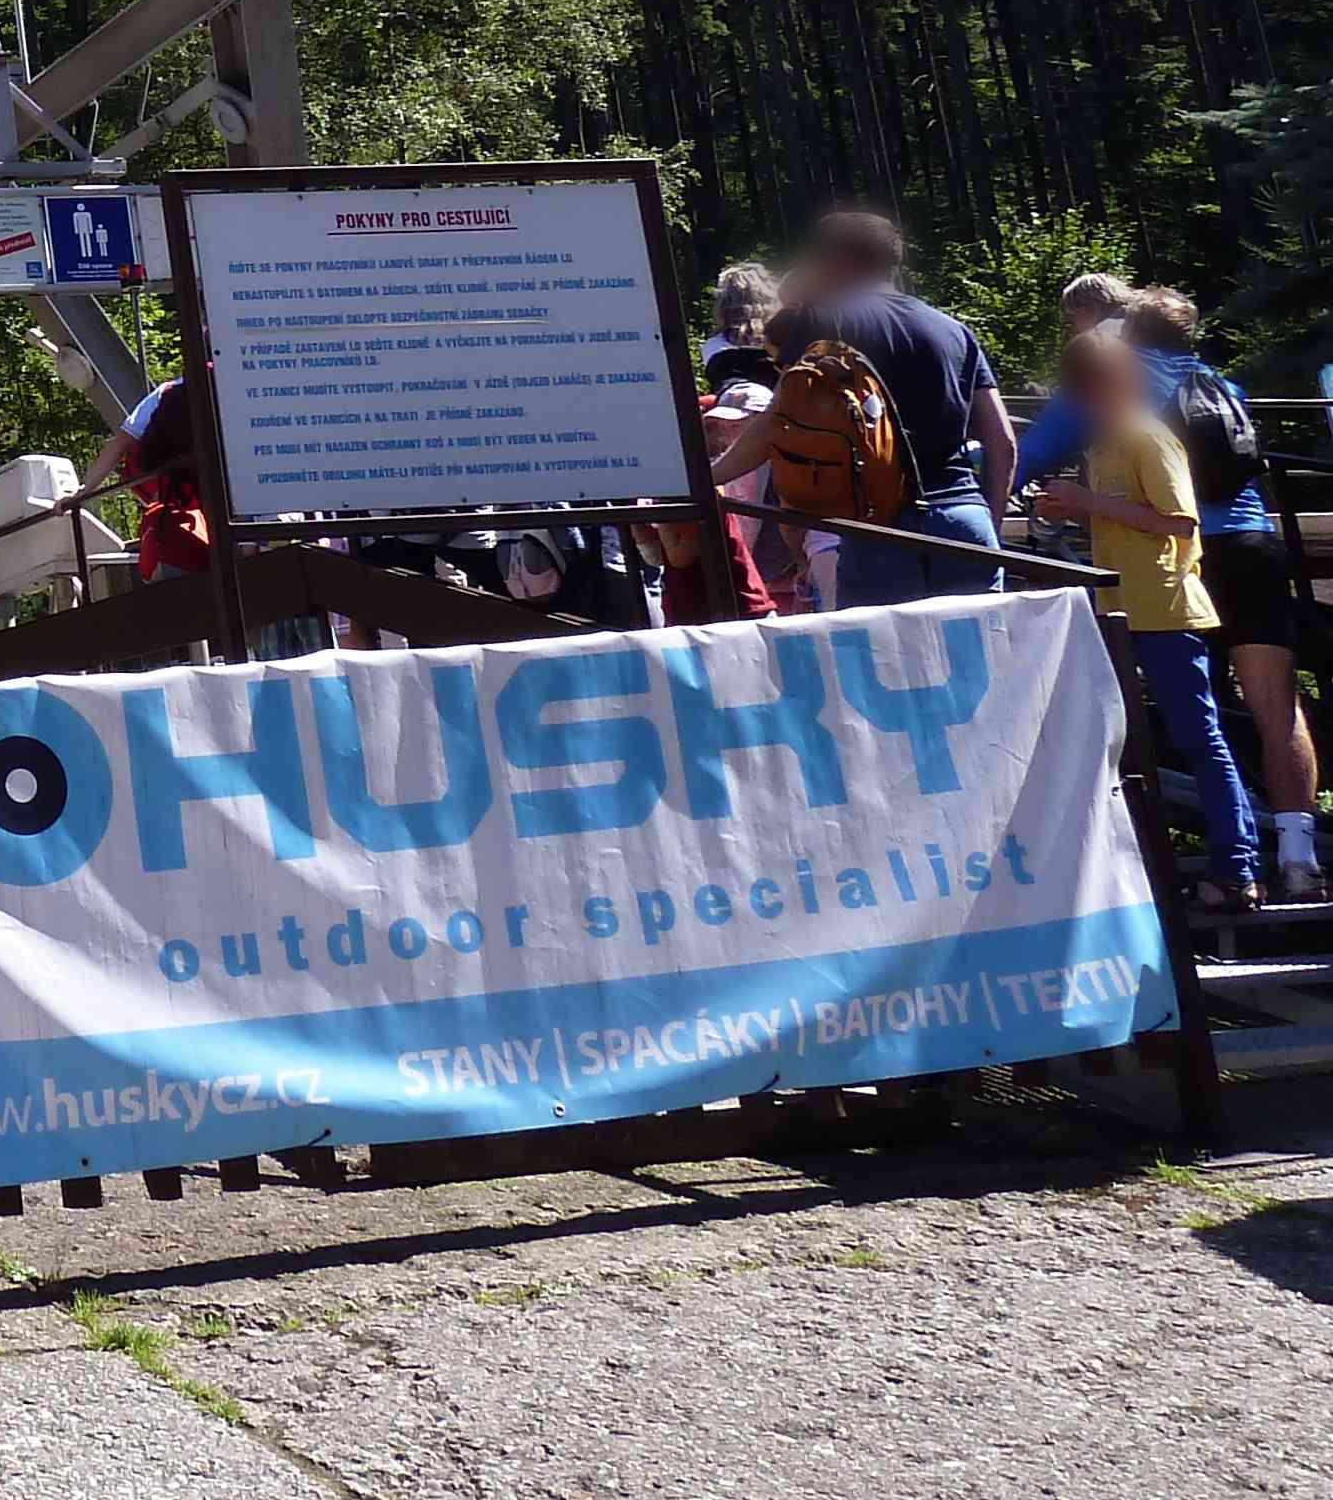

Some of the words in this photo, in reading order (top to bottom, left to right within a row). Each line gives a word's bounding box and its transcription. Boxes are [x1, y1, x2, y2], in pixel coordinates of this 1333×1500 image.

[335, 212, 394, 229] POKYNY
[401, 211, 431, 227] PRO
[436, 205, 511, 226] CESTUJÍCÍ
[240, 345, 247, 355] V
[242, 360, 256, 370] NA
[246, 387, 259, 398] VE
[295, 415, 307, 425] VE
[364, 413, 372, 423] A
[134, 615, 989, 875] HUSKY
[584, 831, 1037, 946] specialist
[158, 899, 532, 985] outdoor
[397, 1037, 542, 1096] STANY
[576, 1006, 781, 1077] SPACÁKY
[815, 980, 971, 1046] BATOHY
